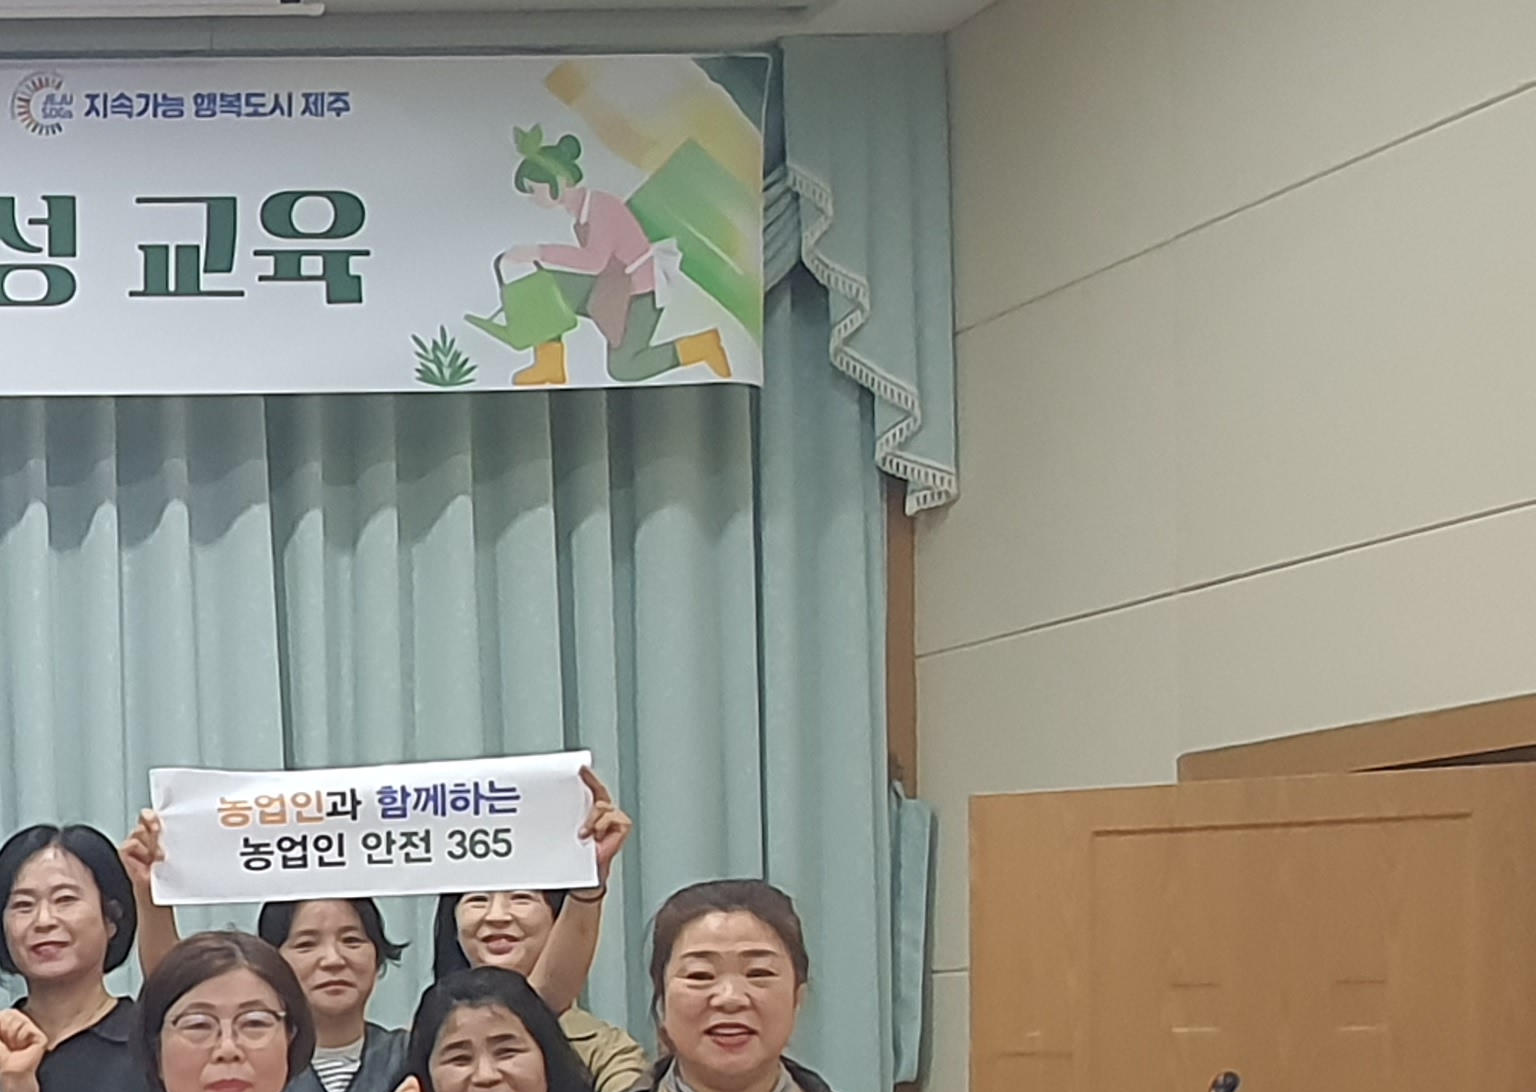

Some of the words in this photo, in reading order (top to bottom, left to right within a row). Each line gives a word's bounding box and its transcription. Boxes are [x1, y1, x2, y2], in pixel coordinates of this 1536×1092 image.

[83, 92, 184, 119] 지속가능
[192, 92, 293, 118] 행복도시
[300, 91, 351, 118] 제주
[128, 188, 372, 305] 교육
[216, 788, 362, 828] 농업인과
[376, 780, 521, 819] 함께하는
[239, 832, 346, 872] 농업인
[360, 829, 433, 865] 안전
[446, 828, 513, 860] 365
